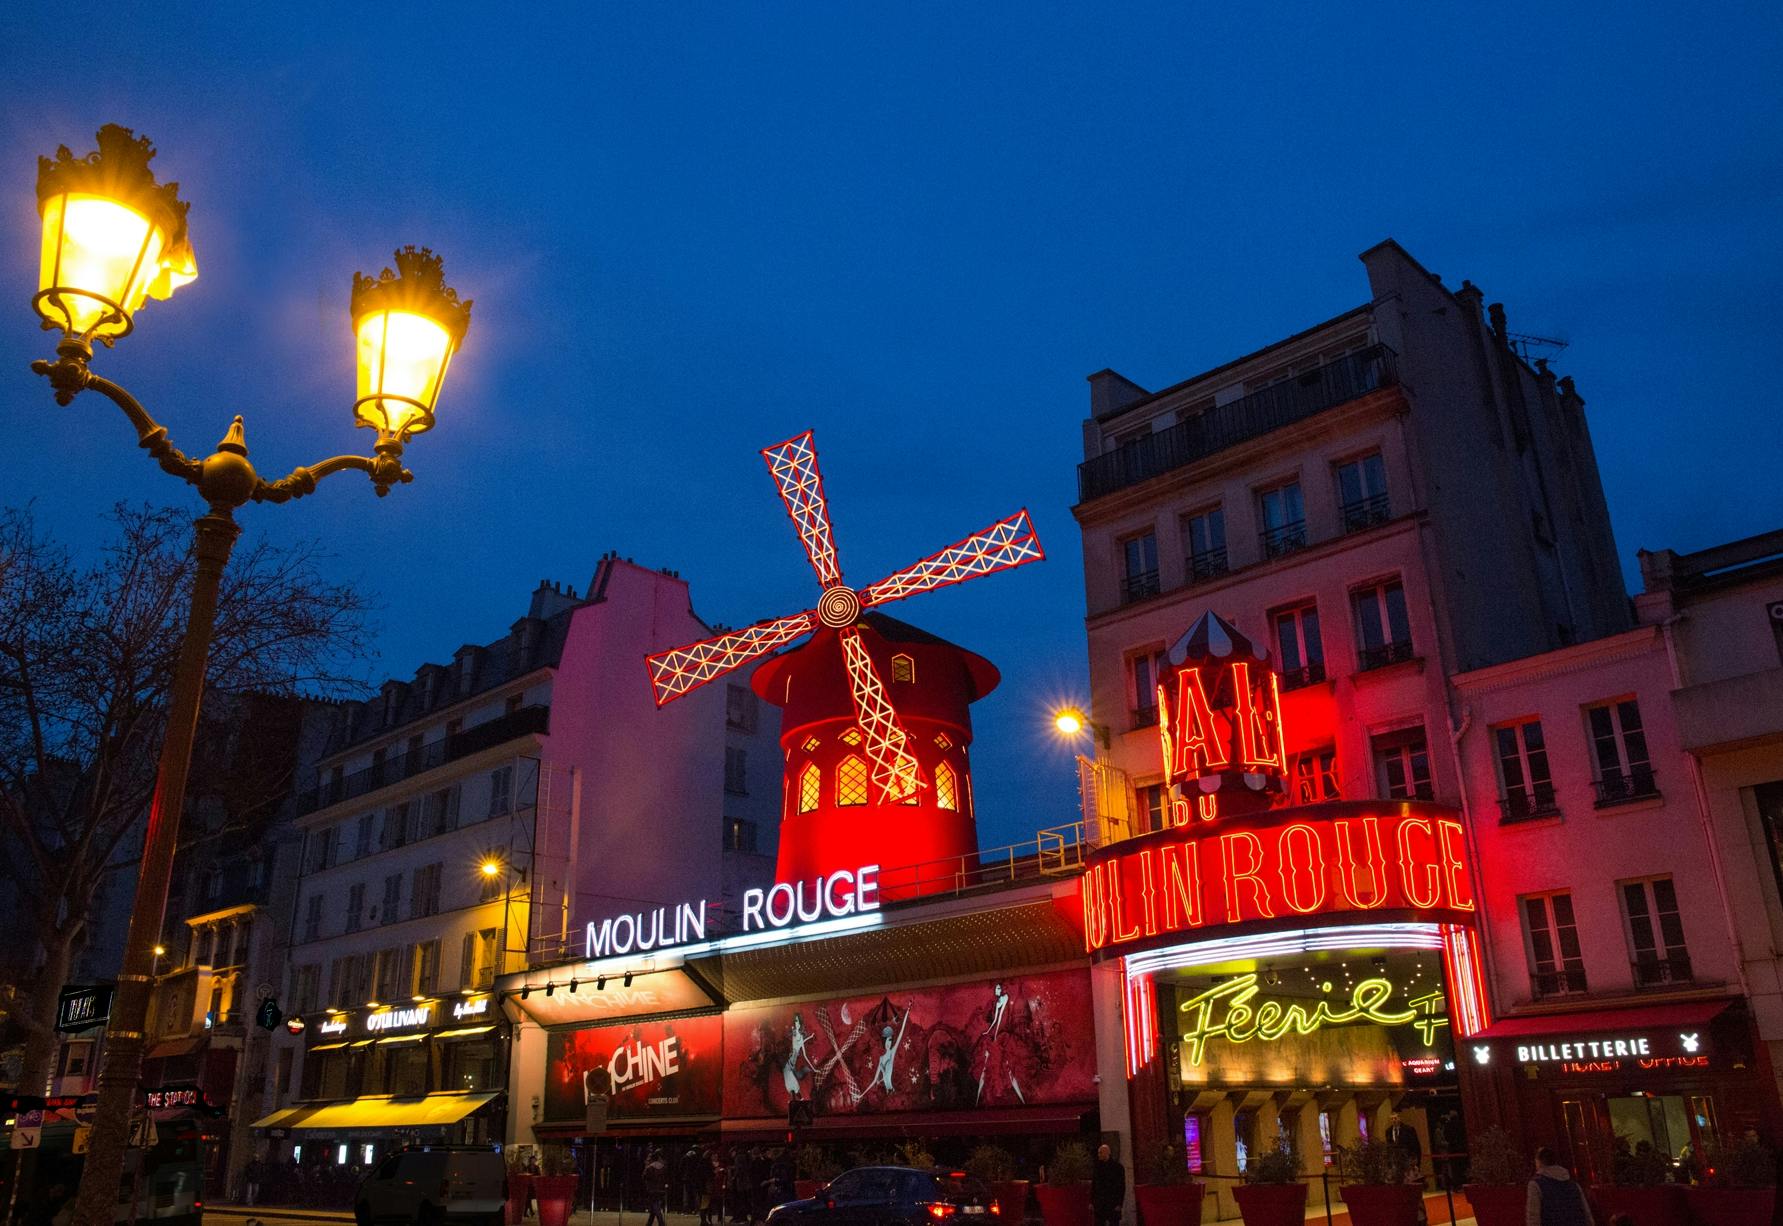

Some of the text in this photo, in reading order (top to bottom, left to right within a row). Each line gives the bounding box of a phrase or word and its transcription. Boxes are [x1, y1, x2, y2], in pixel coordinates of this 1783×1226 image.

[1172, 794, 1217, 827] DU
[585, 864, 880, 958] MOULIN ROUGE
[1082, 818, 1475, 953] ULIN ROUGE
[1180, 973, 1418, 1067] Féerie
[1517, 1038, 1650, 1062] BILLETTERIE
[582, 1035, 680, 1107] CHINE
